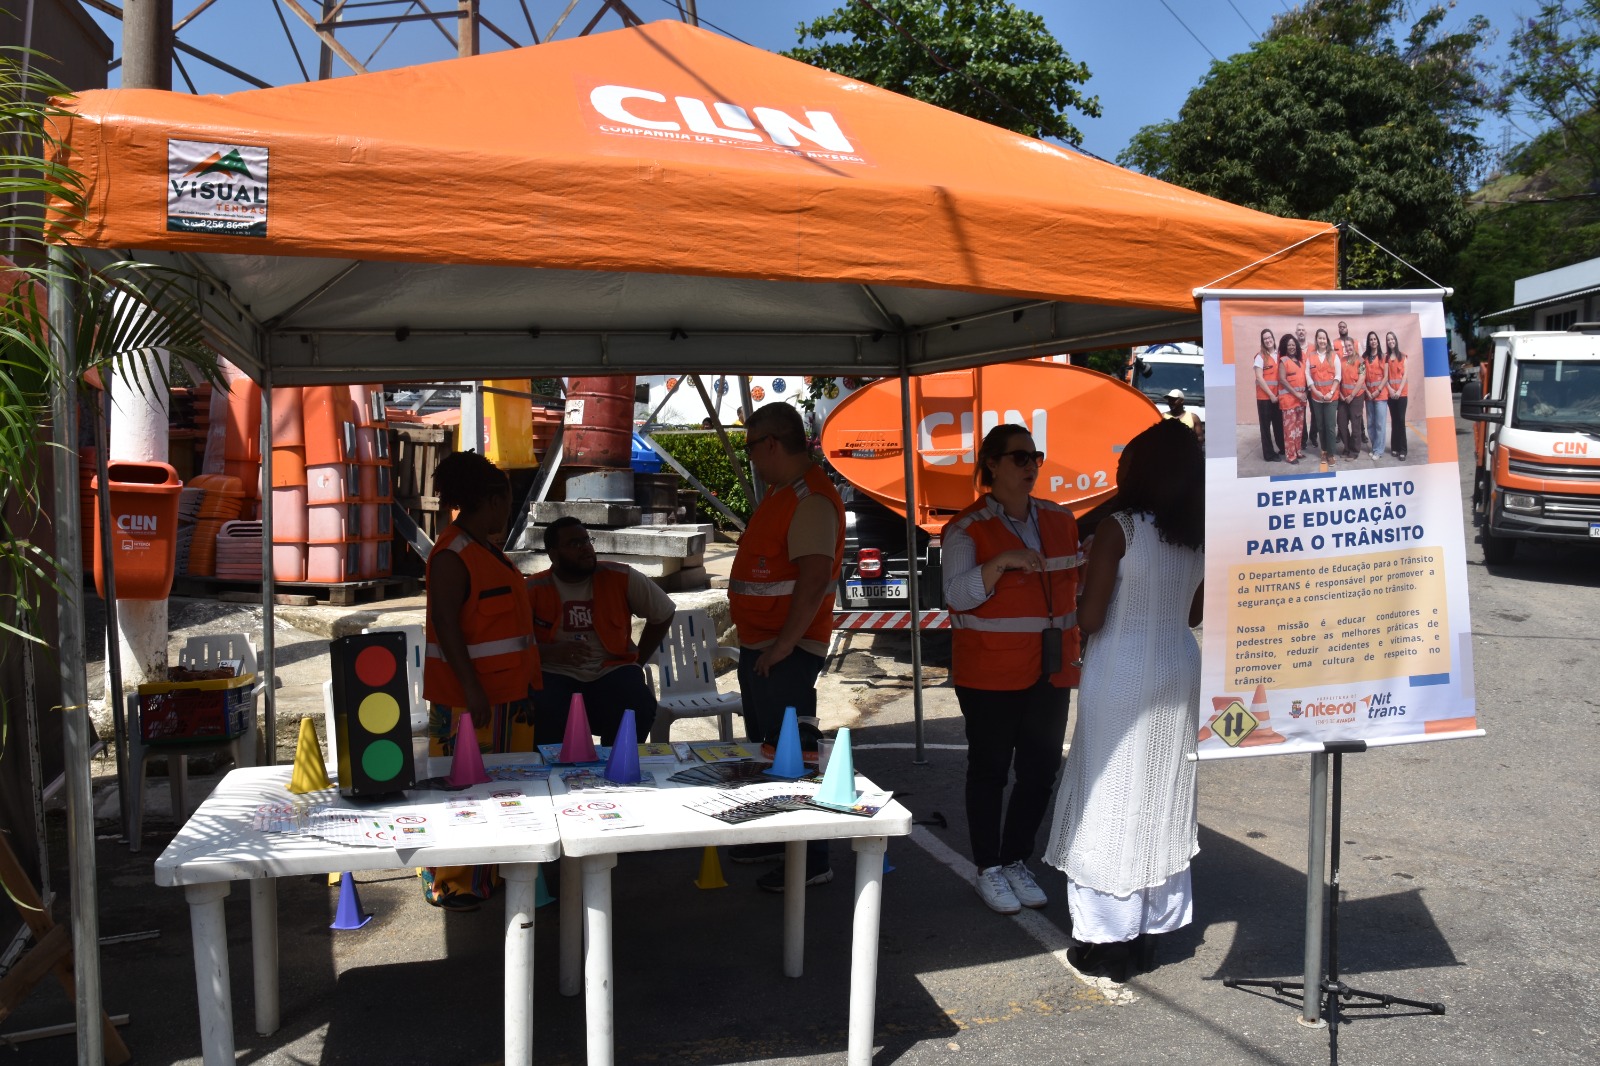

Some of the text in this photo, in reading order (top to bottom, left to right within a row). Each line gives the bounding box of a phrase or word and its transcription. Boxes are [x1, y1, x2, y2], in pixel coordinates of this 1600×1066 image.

[590, 85, 854, 152] CLIN
[216, 203, 266, 215] TENDAS
[1553, 442, 1588, 454] CLIN
[1050, 470, 1108, 492] P-02
[1257, 480, 1415, 507] DEPARTAMENTO
[117, 515, 158, 530] CLIN
[1269, 502, 1407, 530] DE EDUCAÇÃO
[1247, 525, 1424, 555] PARA O TRÂNSITO
[1249, 568, 1315, 581] Departamento
[1318, 566, 1329, 574] de
[1333, 561, 1370, 573] Educação
[1373, 561, 1391, 570] para
[1400, 555, 1433, 565] Trânsito
[1237, 586, 1249, 594] da
[1254, 582, 1300, 593] NITTRANS
[1305, 580, 1310, 588] é
[1315, 575, 1365, 588] responsável
[1370, 574, 1383, 584] por
[1387, 569, 1424, 581] promover
[1237, 597, 1285, 608] segurança
[1304, 588, 1371, 602] conscientização
[1373, 587, 1383, 595] no
[1385, 583, 1416, 593] trânsito.
[1277, 620, 1309, 631] missão
[1321, 619, 1326, 627] é
[1337, 616, 1366, 626] educar
[1376, 609, 1420, 621] condutores
[1236, 620, 1439, 648] pedestres sobre as melhores práticas de
[1236, 650, 1277, 660] trânsito,
[1287, 646, 1319, 656] reduzir
[1328, 641, 1370, 652] acidentes
[1391, 635, 1424, 645] vítimas,
[1235, 663, 1282, 674] promover
[1292, 661, 1312, 669] uma
[1323, 656, 1355, 665] cultura
[1364, 653, 1375, 661] de
[1384, 648, 1417, 659] respeito
[1234, 676, 1275, 685] trânsito.
[1371, 692, 1391, 706] Nit
[1368, 705, 1406, 719] trans
